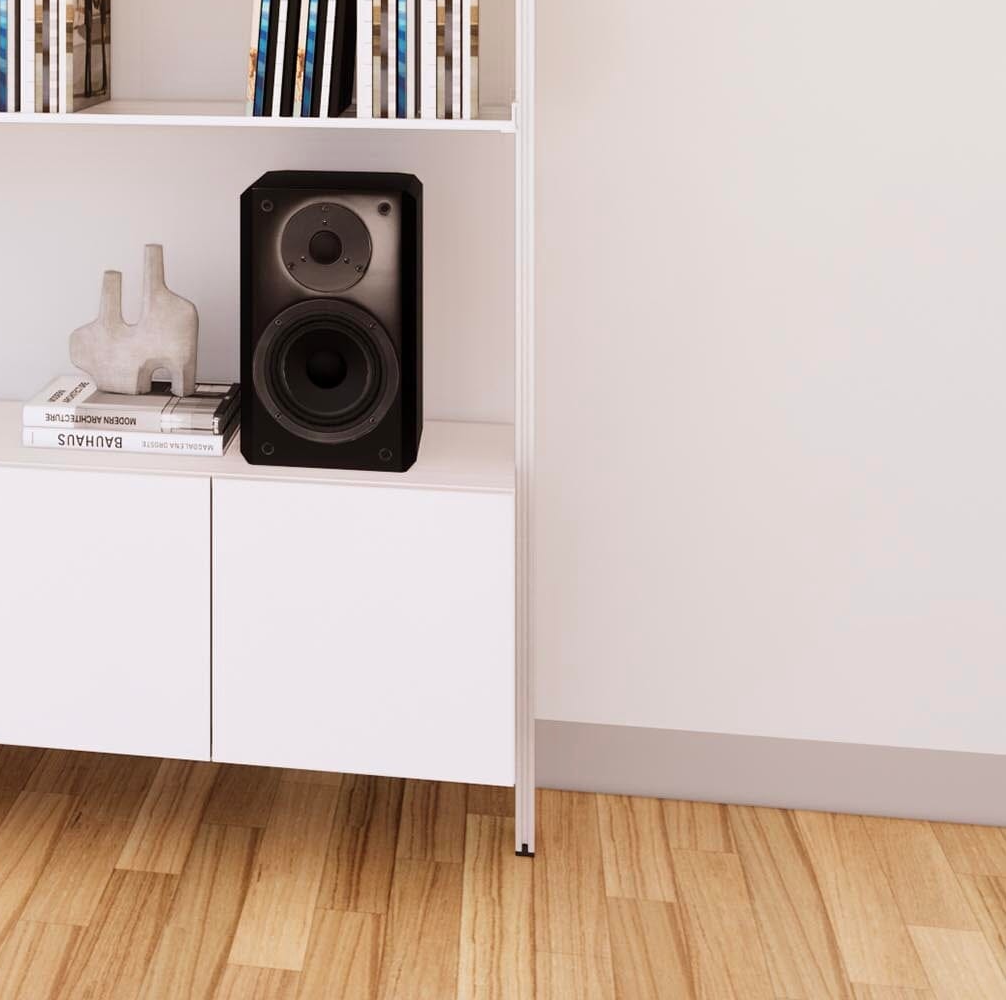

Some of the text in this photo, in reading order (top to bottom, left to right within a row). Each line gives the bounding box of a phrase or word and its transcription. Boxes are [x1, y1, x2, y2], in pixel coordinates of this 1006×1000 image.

[45, 413, 136, 425] MODERN ARCHITECTURE
[58, 434, 122, 448] BAUHAUS
[170, 442, 214, 451] MAGDALENA
